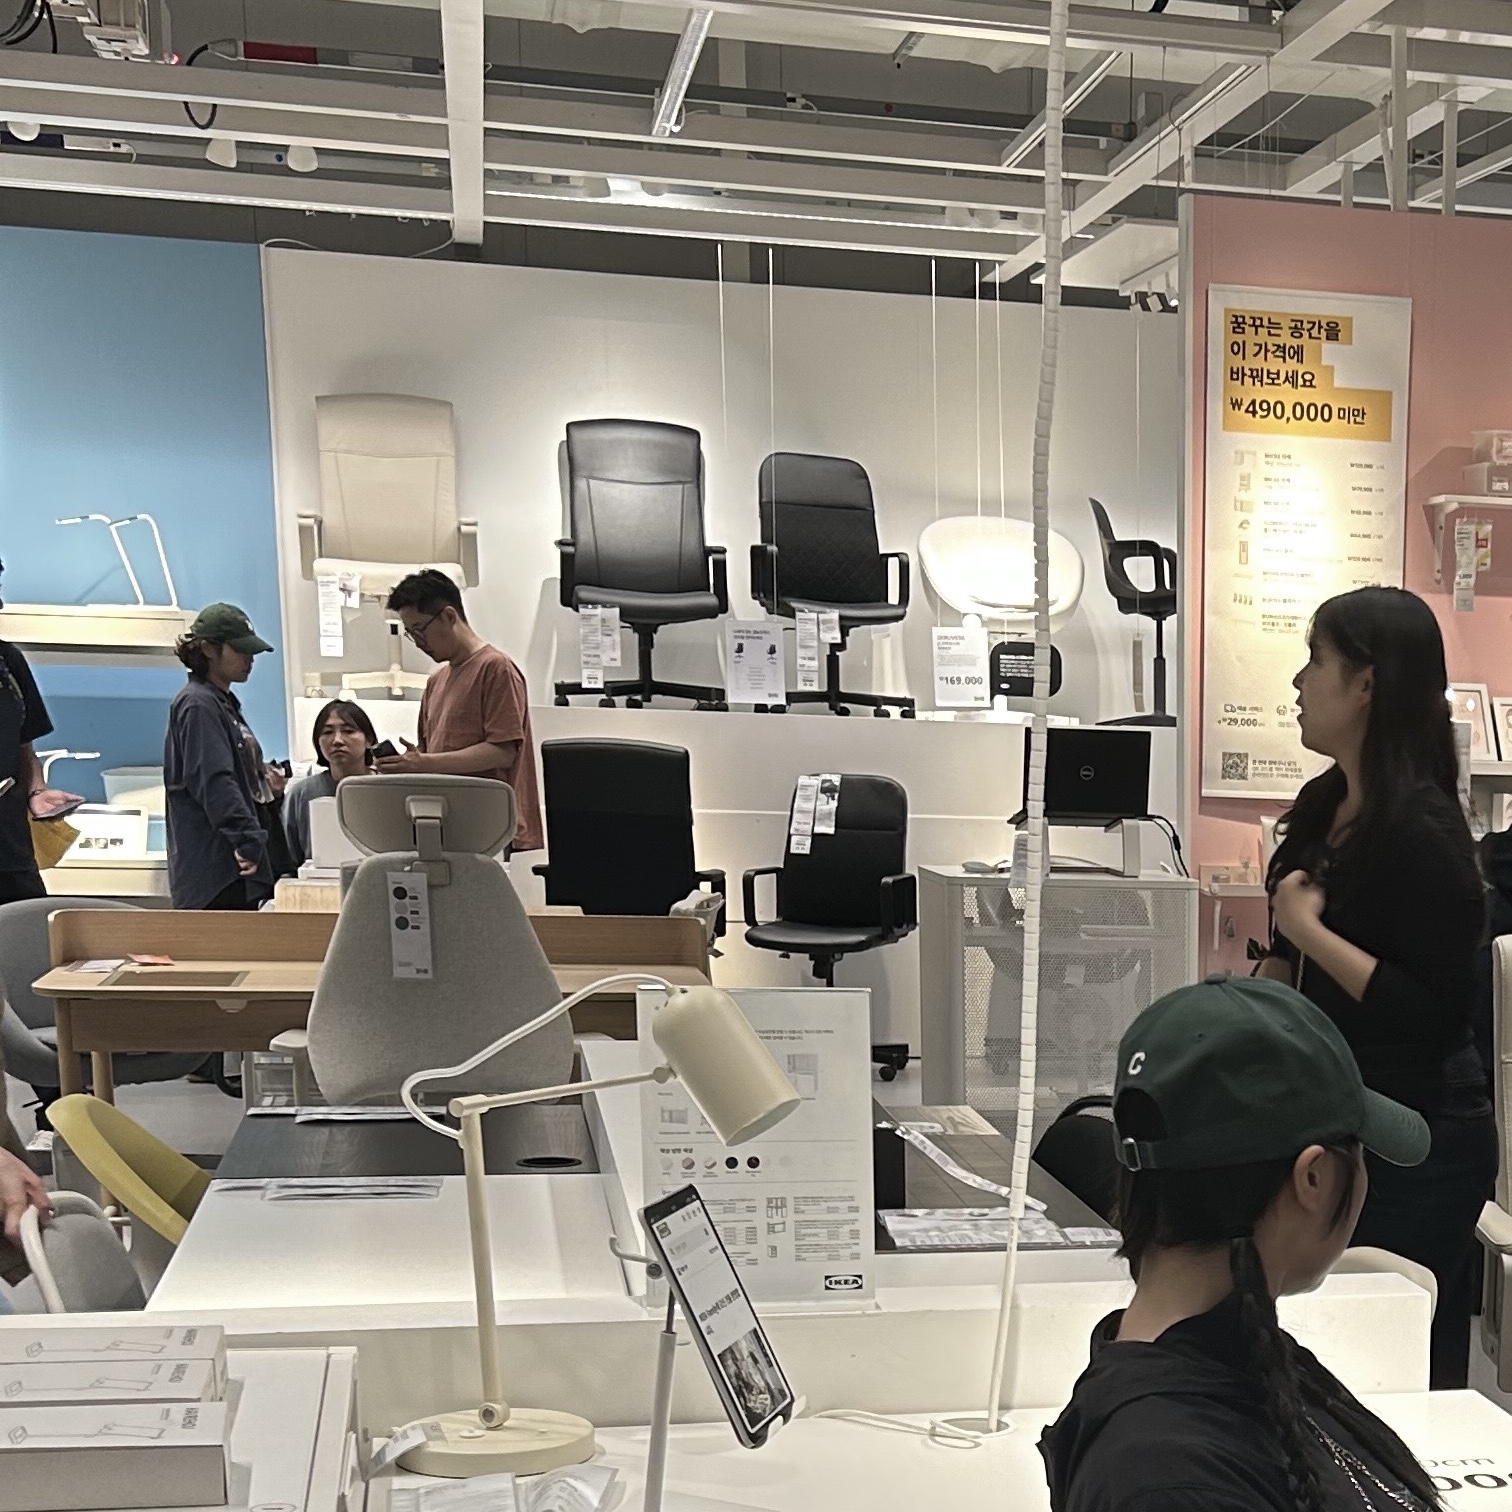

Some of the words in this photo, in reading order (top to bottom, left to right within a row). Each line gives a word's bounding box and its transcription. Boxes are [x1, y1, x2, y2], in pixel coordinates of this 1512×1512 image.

[1230, 314, 1283, 337] 꿈꾸는
[1288, 318, 1341, 342] 공간을
[1230, 340, 1247, 361] 이
[1253, 341, 1304, 364] 가격에
[1229, 365, 1317, 390] 바꿔보세요
[1337, 406, 1367, 425] 미만
[1127, 1051, 1146, 1075] C
